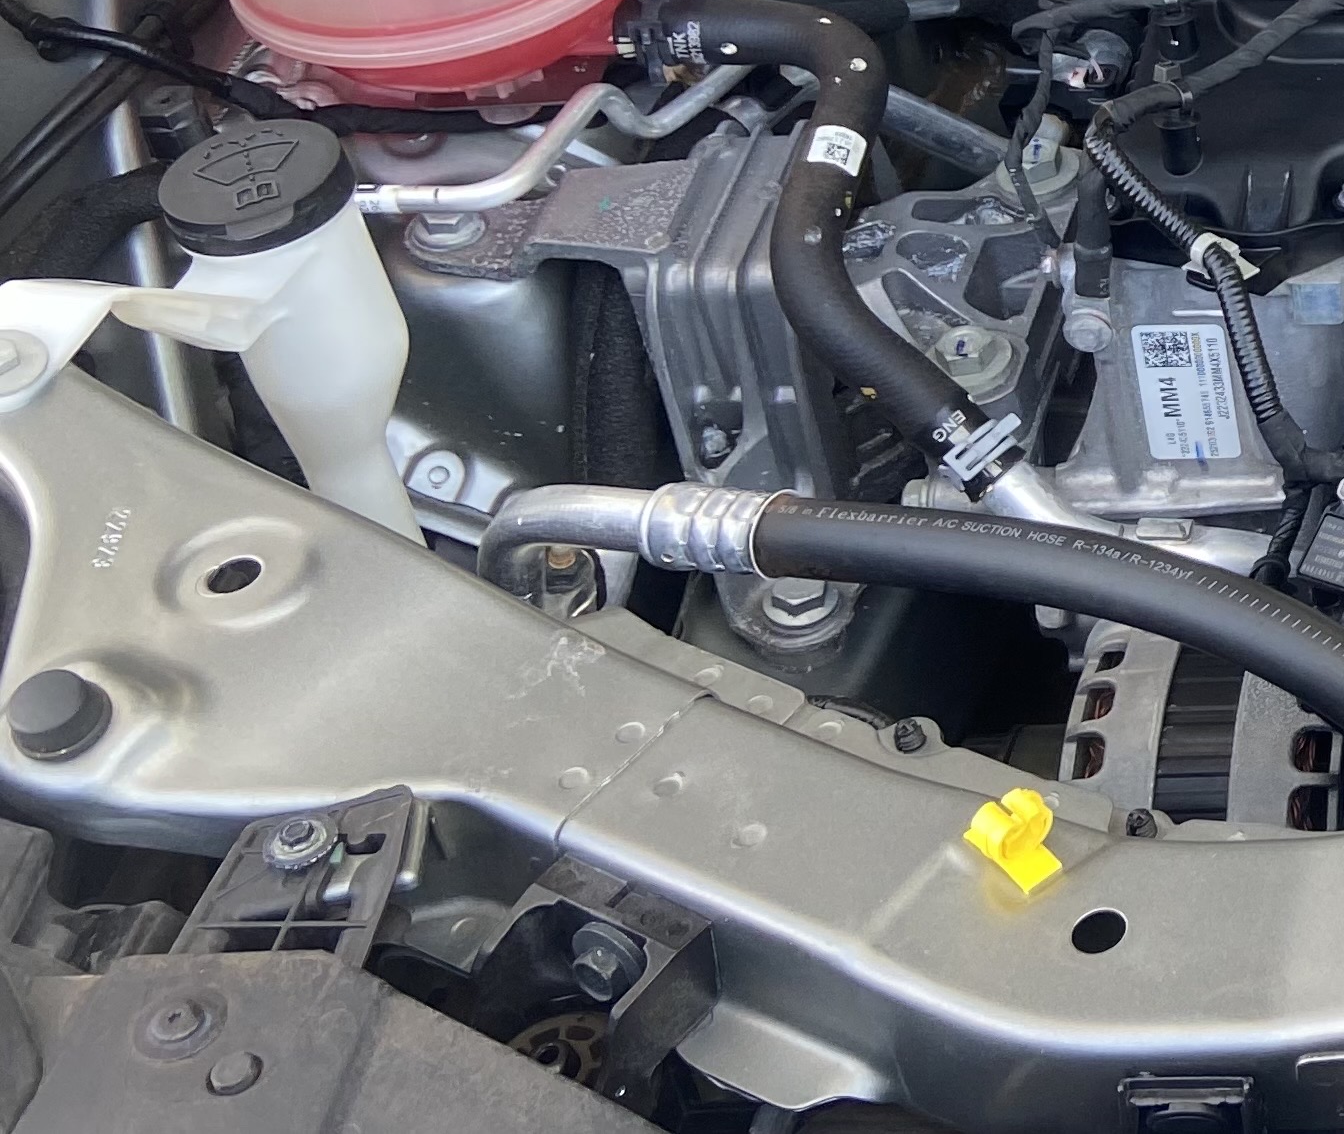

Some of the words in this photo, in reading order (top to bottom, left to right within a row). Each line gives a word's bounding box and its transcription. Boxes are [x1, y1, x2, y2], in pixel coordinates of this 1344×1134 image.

[672, 32, 690, 59] TNK
[1158, 377, 1183, 418] MM4
[932, 411, 967, 444] ENG
[816, 506, 928, 527] Flexbarrier
[933, 516, 958, 530] A/C
[1026, 530, 1066, 547] HOSE
